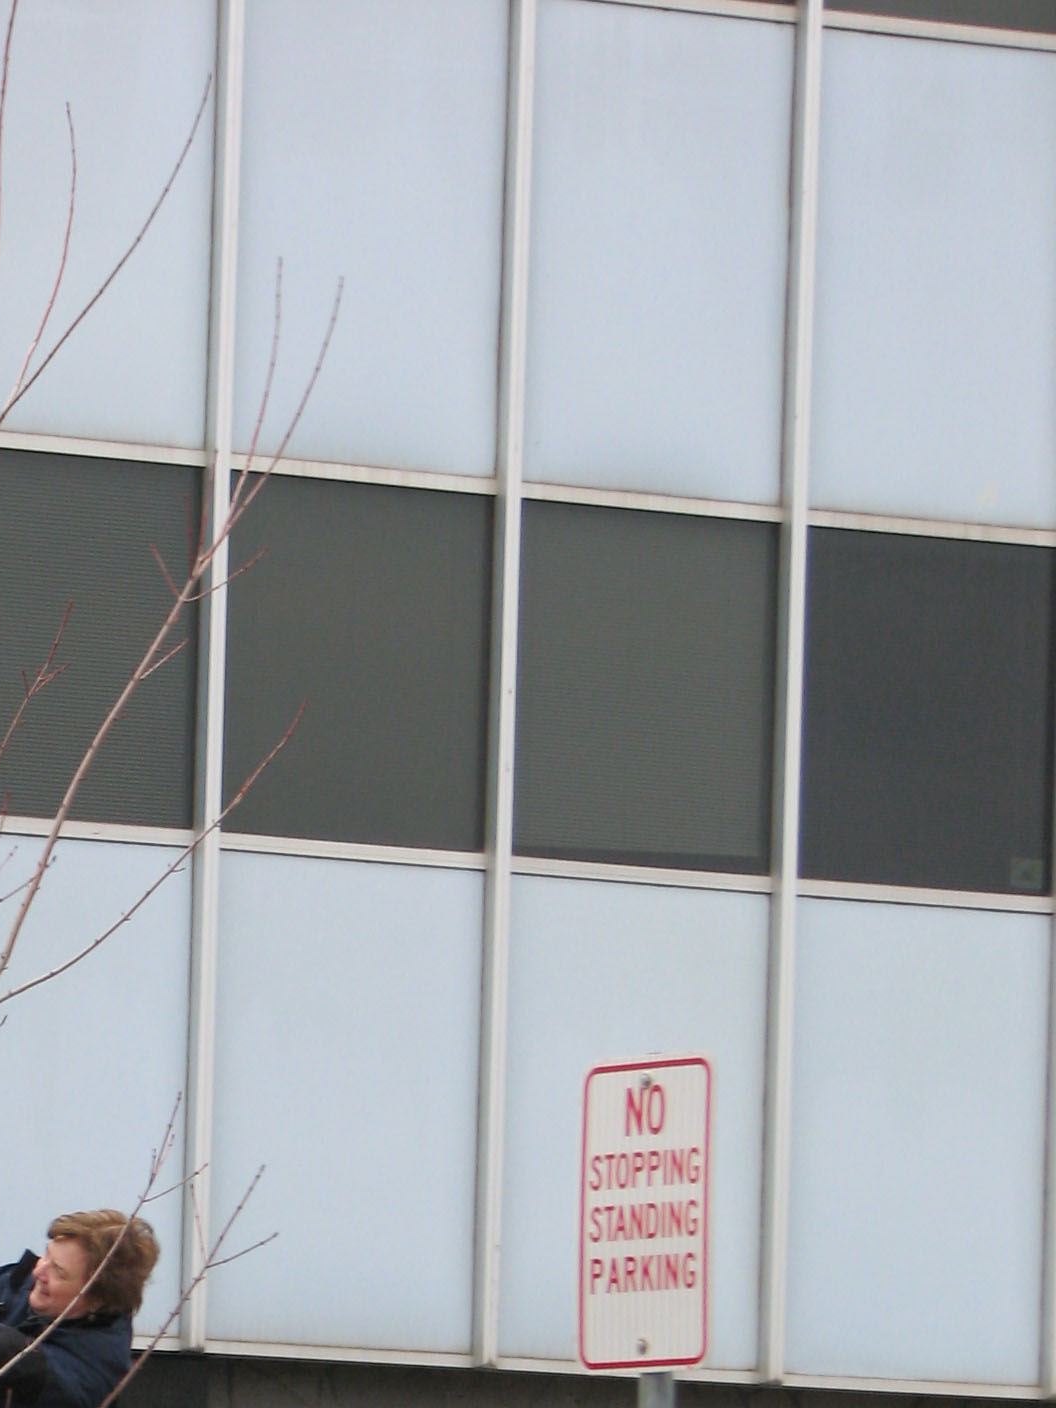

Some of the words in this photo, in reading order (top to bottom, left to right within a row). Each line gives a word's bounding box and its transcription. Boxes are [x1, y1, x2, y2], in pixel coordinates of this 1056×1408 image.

[625, 1085, 665, 1136] NO
[590, 1148, 700, 1190] STOPPING
[590, 1200, 699, 1242] STANDING
[590, 1252, 697, 1294] PARKING
